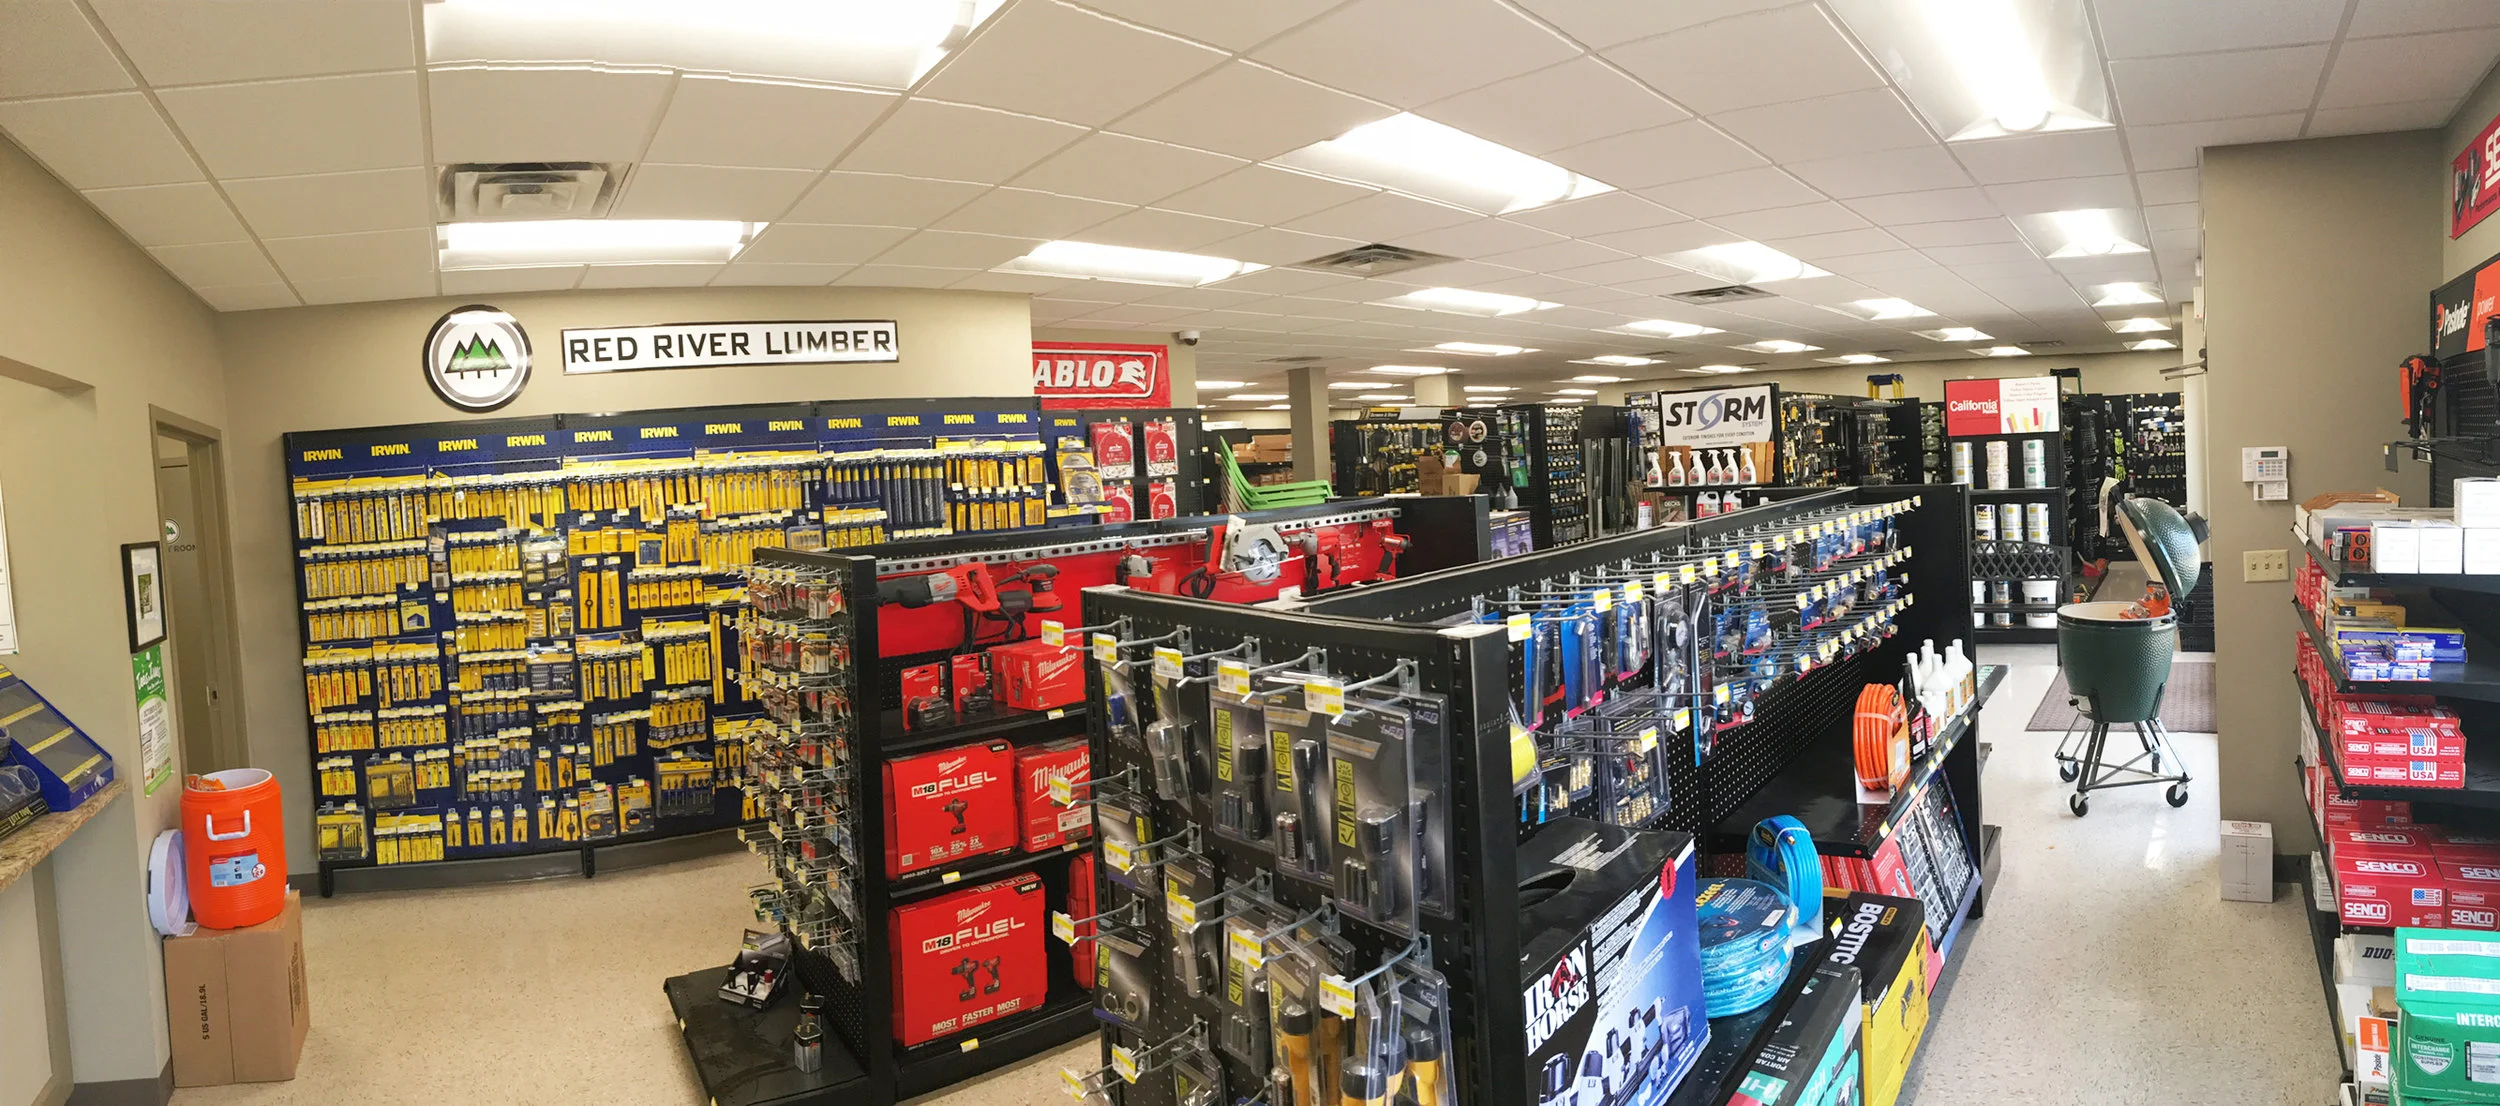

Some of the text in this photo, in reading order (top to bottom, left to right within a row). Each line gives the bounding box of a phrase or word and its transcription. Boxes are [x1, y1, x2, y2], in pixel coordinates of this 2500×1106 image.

[570, 330, 891, 363] RED RIVER LUMBER
[1033, 360, 1115, 388] ABLO
[1950, 399, 1997, 411] California
[944, 413, 975, 424] IRWIN
[998, 413, 1027, 424] IRWIN
[1666, 393, 1765, 431] STORM
[769, 420, 804, 432] IRWIN
[828, 418, 863, 429] IRWIN
[887, 415, 920, 427] IRWIN
[641, 426, 679, 440] IRWIN
[705, 423, 742, 435] IRWIN
[507, 434, 547, 448] IRWIN
[574, 430, 613, 443] IRWIN
[371, 444, 411, 457] IRWIN
[439, 439, 478, 452] IRWIN
[304, 449, 343, 462] IRWIN
[1036, 652, 1077, 678] Milwaukee
[2412, 747, 2434, 755] USA
[2412, 771, 2434, 780] USA
[913, 771, 997, 796] M18 FUEL
[2350, 832, 2408, 841] SENCO
[2355, 861, 2418, 872] SENCO
[1021, 883, 1037, 892] NEW
[957, 901, 991, 922] Milwaukee
[2345, 904, 2386, 916] SENCO
[2451, 910, 2494, 922] SENCO
[925, 917, 1025, 951] M18 FUEL
[1524, 940, 1588, 1029] IRON
[199, 983, 209, 1021] GAL/18.9L
[932, 997, 1021, 1033] MOST FASTER MOST
[1526, 976, 1589, 1057] HORSE
[202, 1022, 210, 1032] US
[2411, 1043, 2450, 1053] INTERCHANGE
[2373, 1054, 2382, 1072] Paslode
